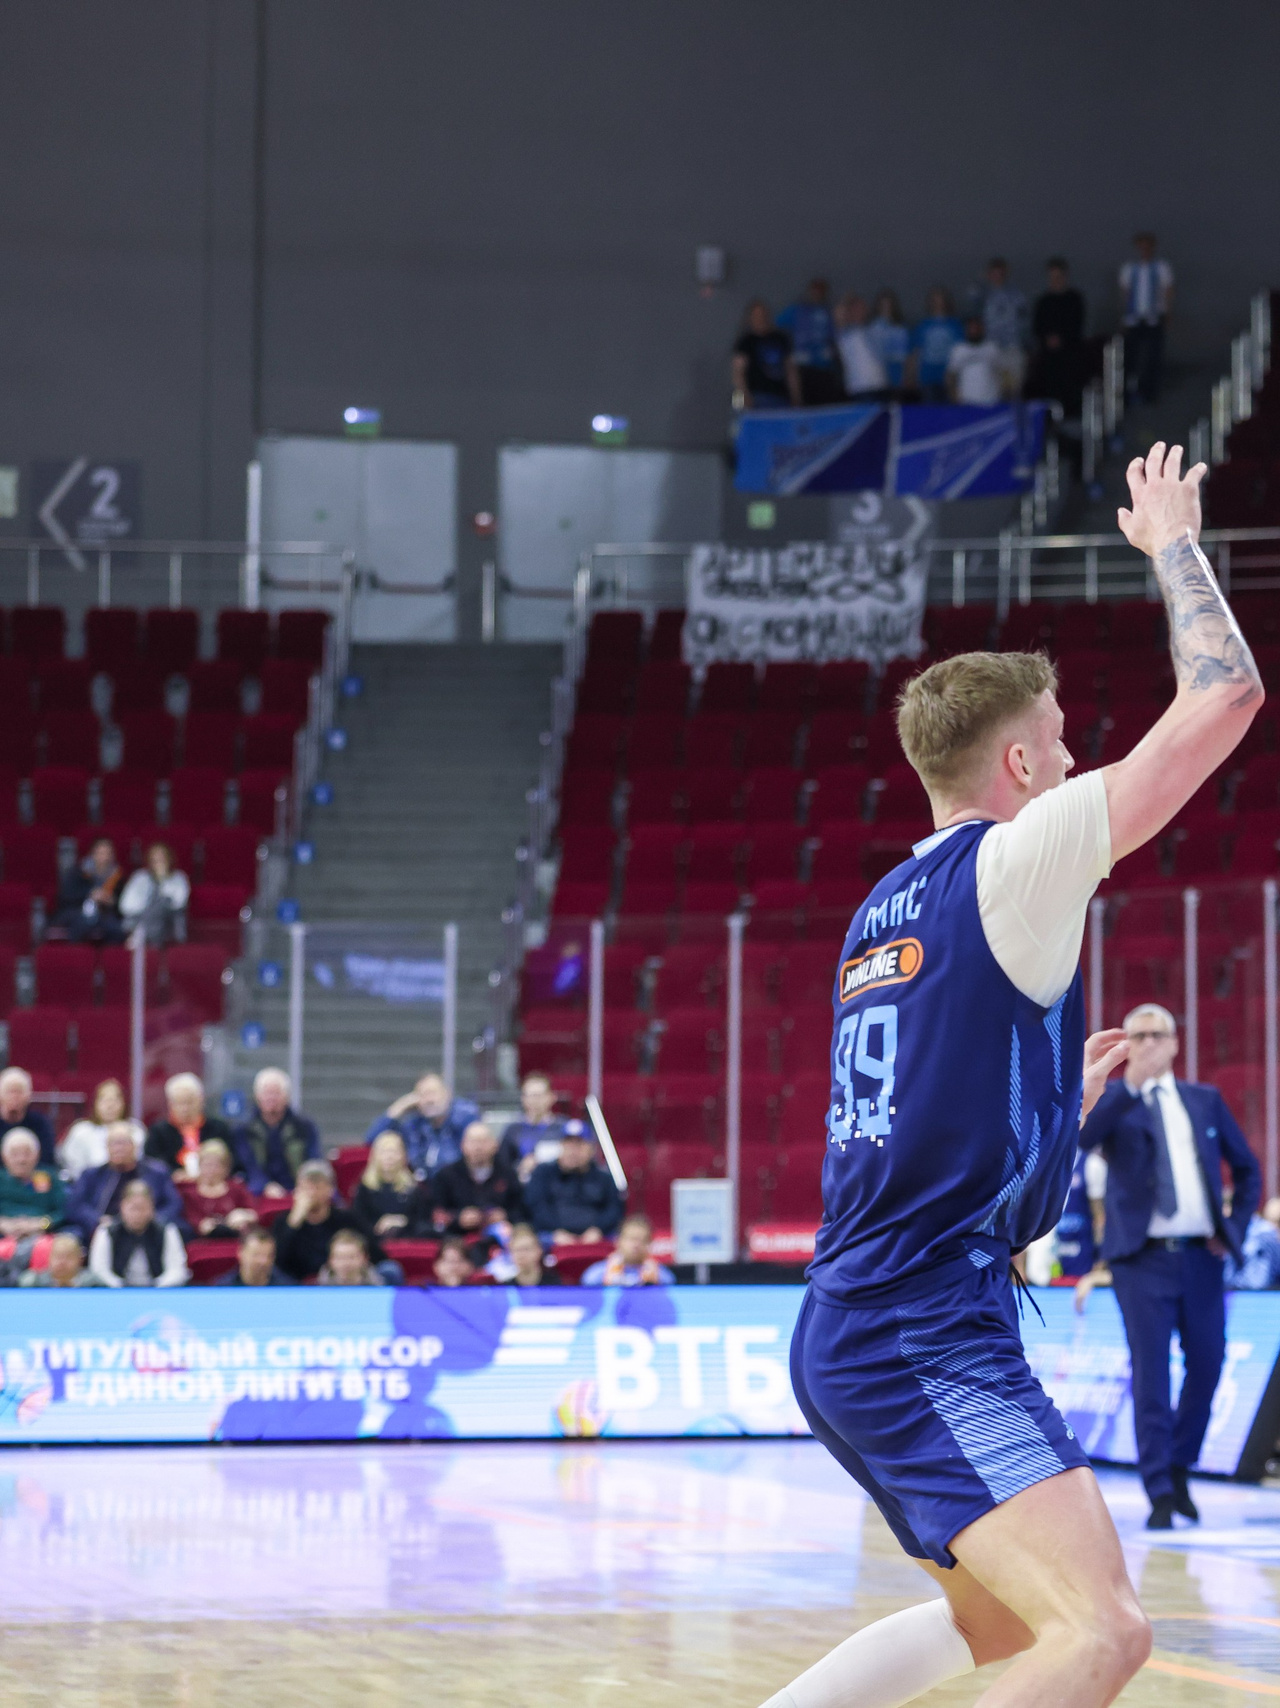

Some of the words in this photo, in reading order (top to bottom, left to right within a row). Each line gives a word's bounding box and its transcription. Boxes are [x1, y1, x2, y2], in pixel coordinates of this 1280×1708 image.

[91, 467, 119, 519] 2
[830, 1004, 899, 1146] 99
[29, 1334, 258, 1370] ТИТУЛЬНЫЙ
[266, 1336, 443, 1368] СПОНСОР
[594, 1326, 790, 1411] ВТБ
[64, 1369, 226, 1406] ЕДИНОЙ
[231, 1370, 335, 1402] ЛИГИ
[341, 1370, 411, 1401] ВТБ
